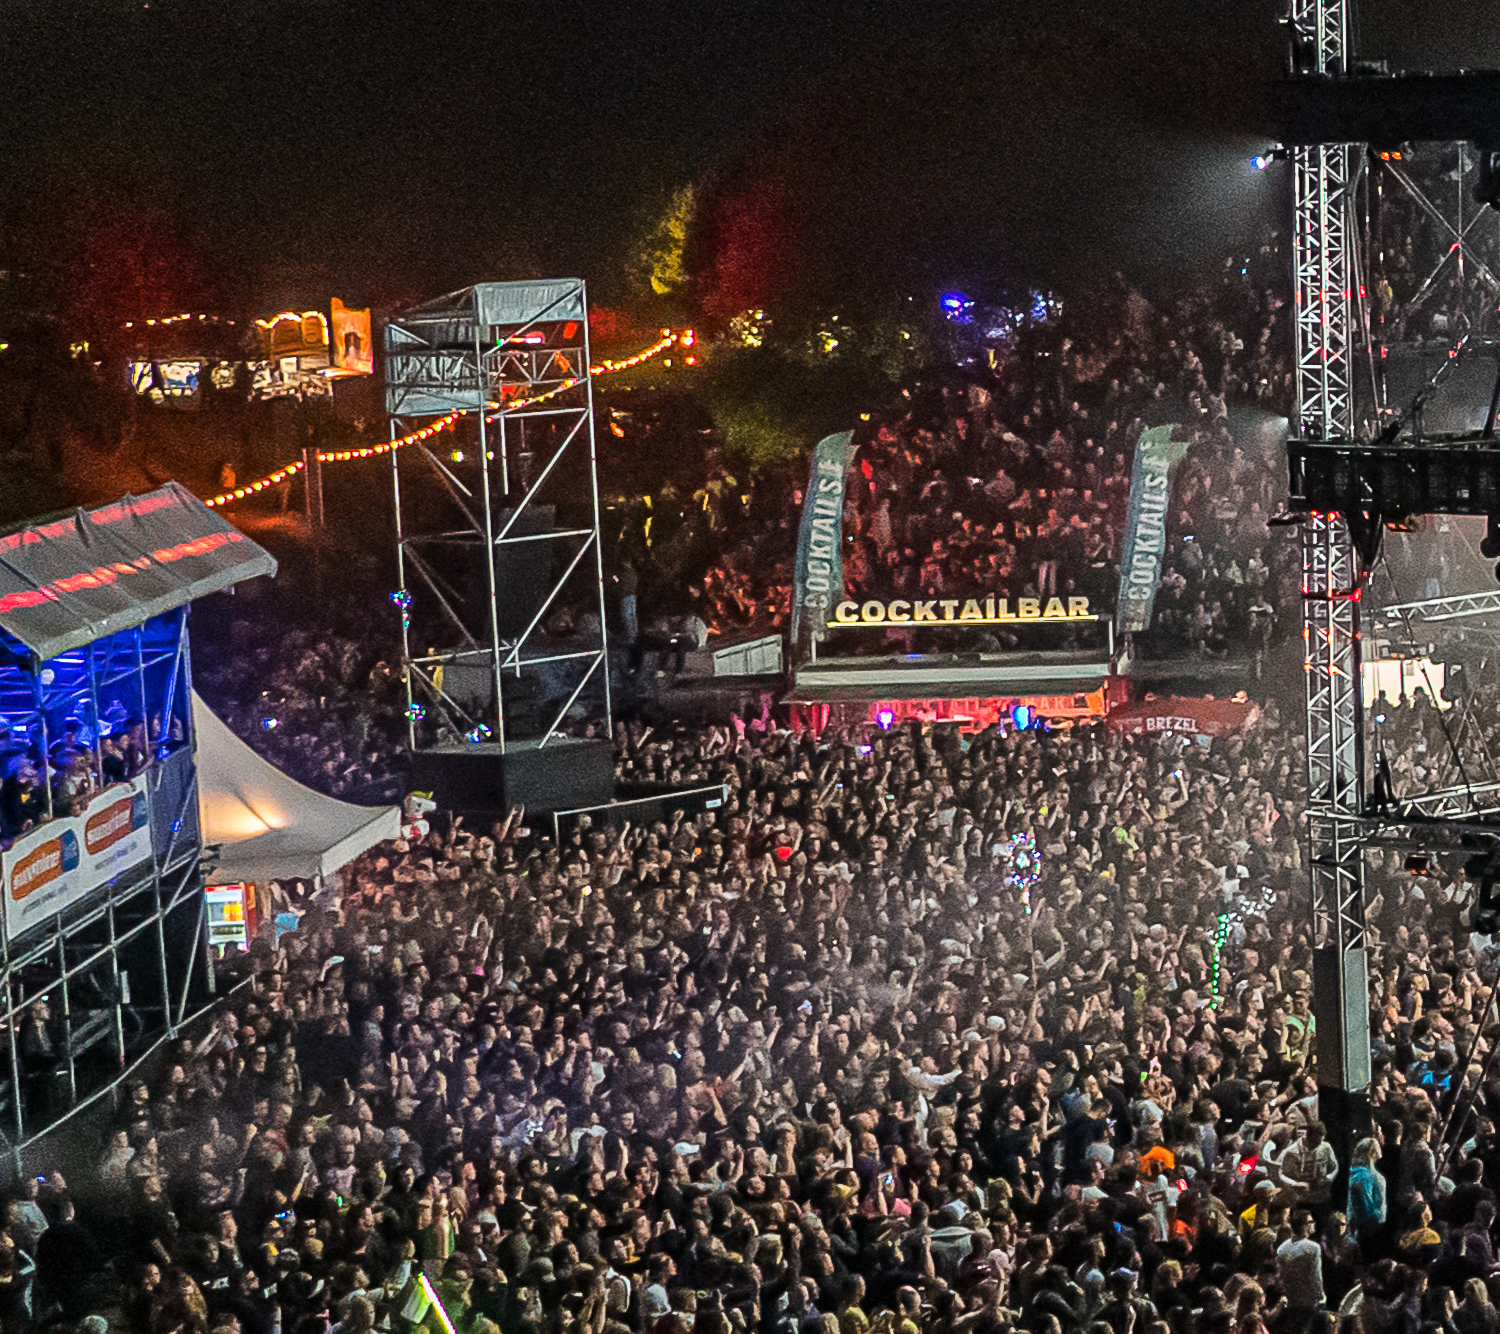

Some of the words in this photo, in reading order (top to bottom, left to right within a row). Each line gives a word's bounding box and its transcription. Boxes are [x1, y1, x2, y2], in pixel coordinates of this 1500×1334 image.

[803, 477, 843, 609] COCKTAILS
[1127, 473, 1168, 601] COCKTAILS
[836, 596, 1090, 622] COCKTAILBAR
[1146, 717, 1199, 732] BREZEL
